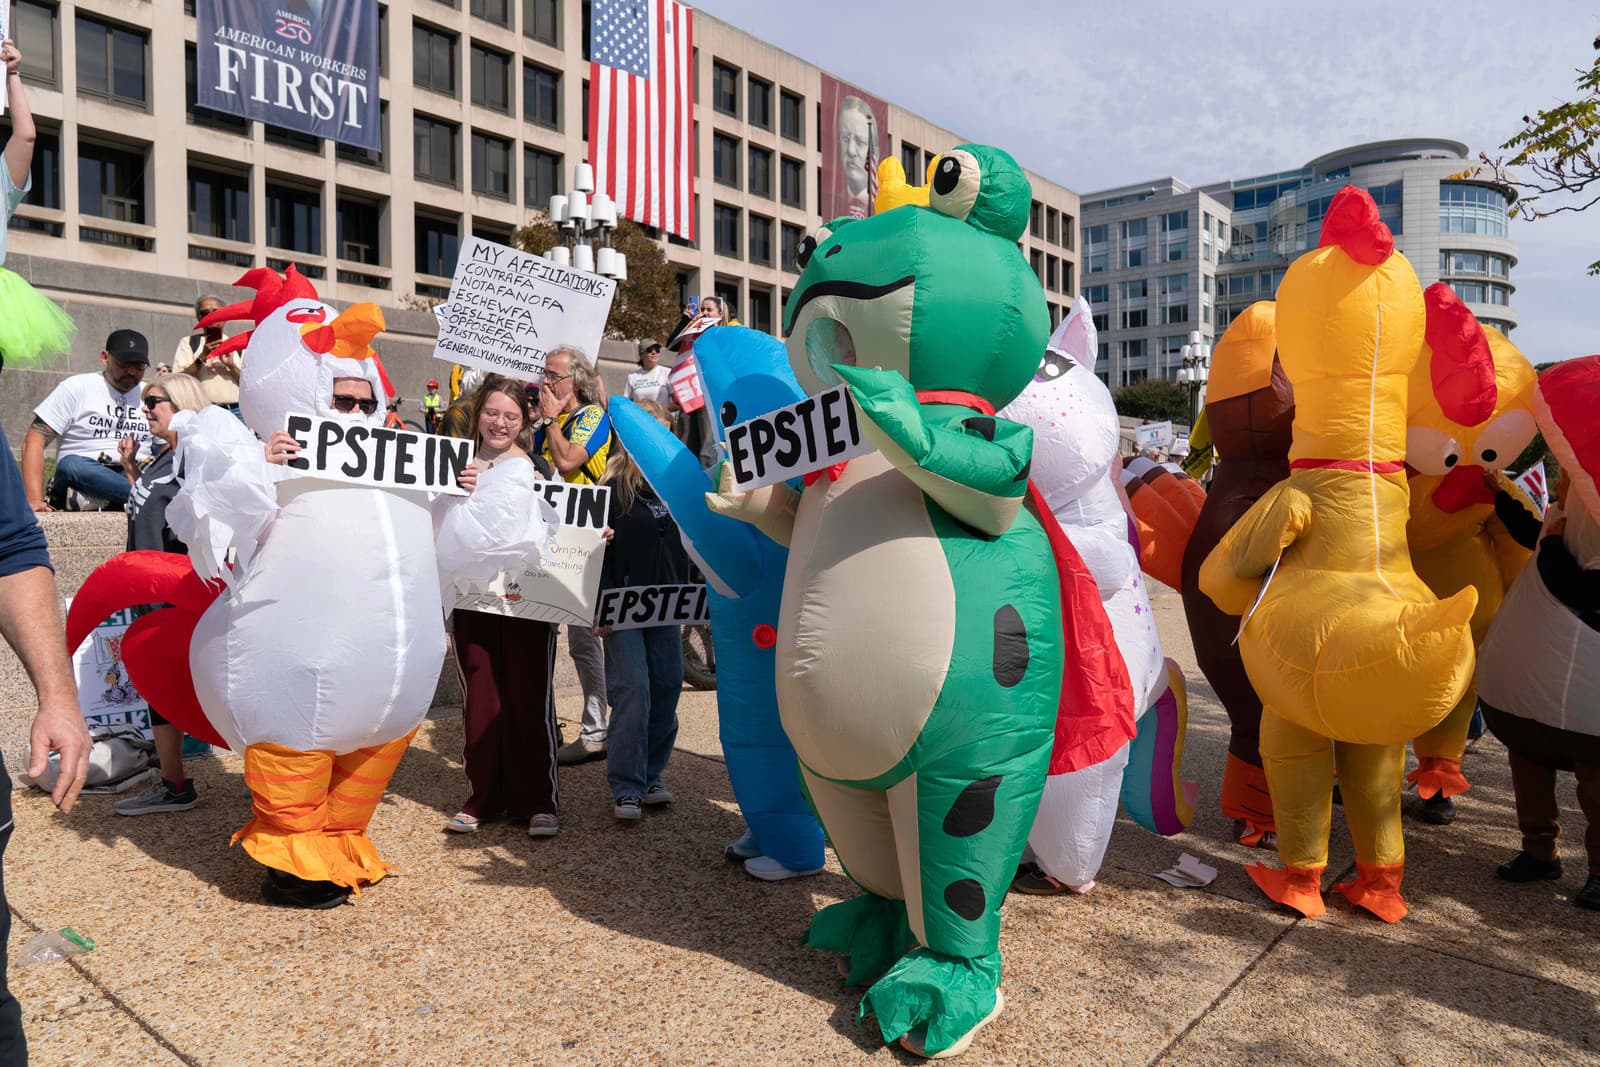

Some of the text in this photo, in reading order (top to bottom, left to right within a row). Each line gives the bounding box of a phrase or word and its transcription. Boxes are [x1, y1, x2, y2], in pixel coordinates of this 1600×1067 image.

[275, 9, 312, 26] AMERICA
[275, 18, 312, 45] 250
[214, 25, 367, 81] AMERICAN WORKERS
[214, 42, 368, 129] FIRST
[472, 243, 609, 297] MY AFFILIATIONS:
[89, 416, 150, 432] CAN GARGL
[107, 405, 141, 420] I.C.E.
[93, 429, 149, 442] MY BALS
[287, 416, 469, 489] EPSTEIN
[729, 387, 860, 484] EPSTEI
[599, 586, 710, 628] EPSTEI
